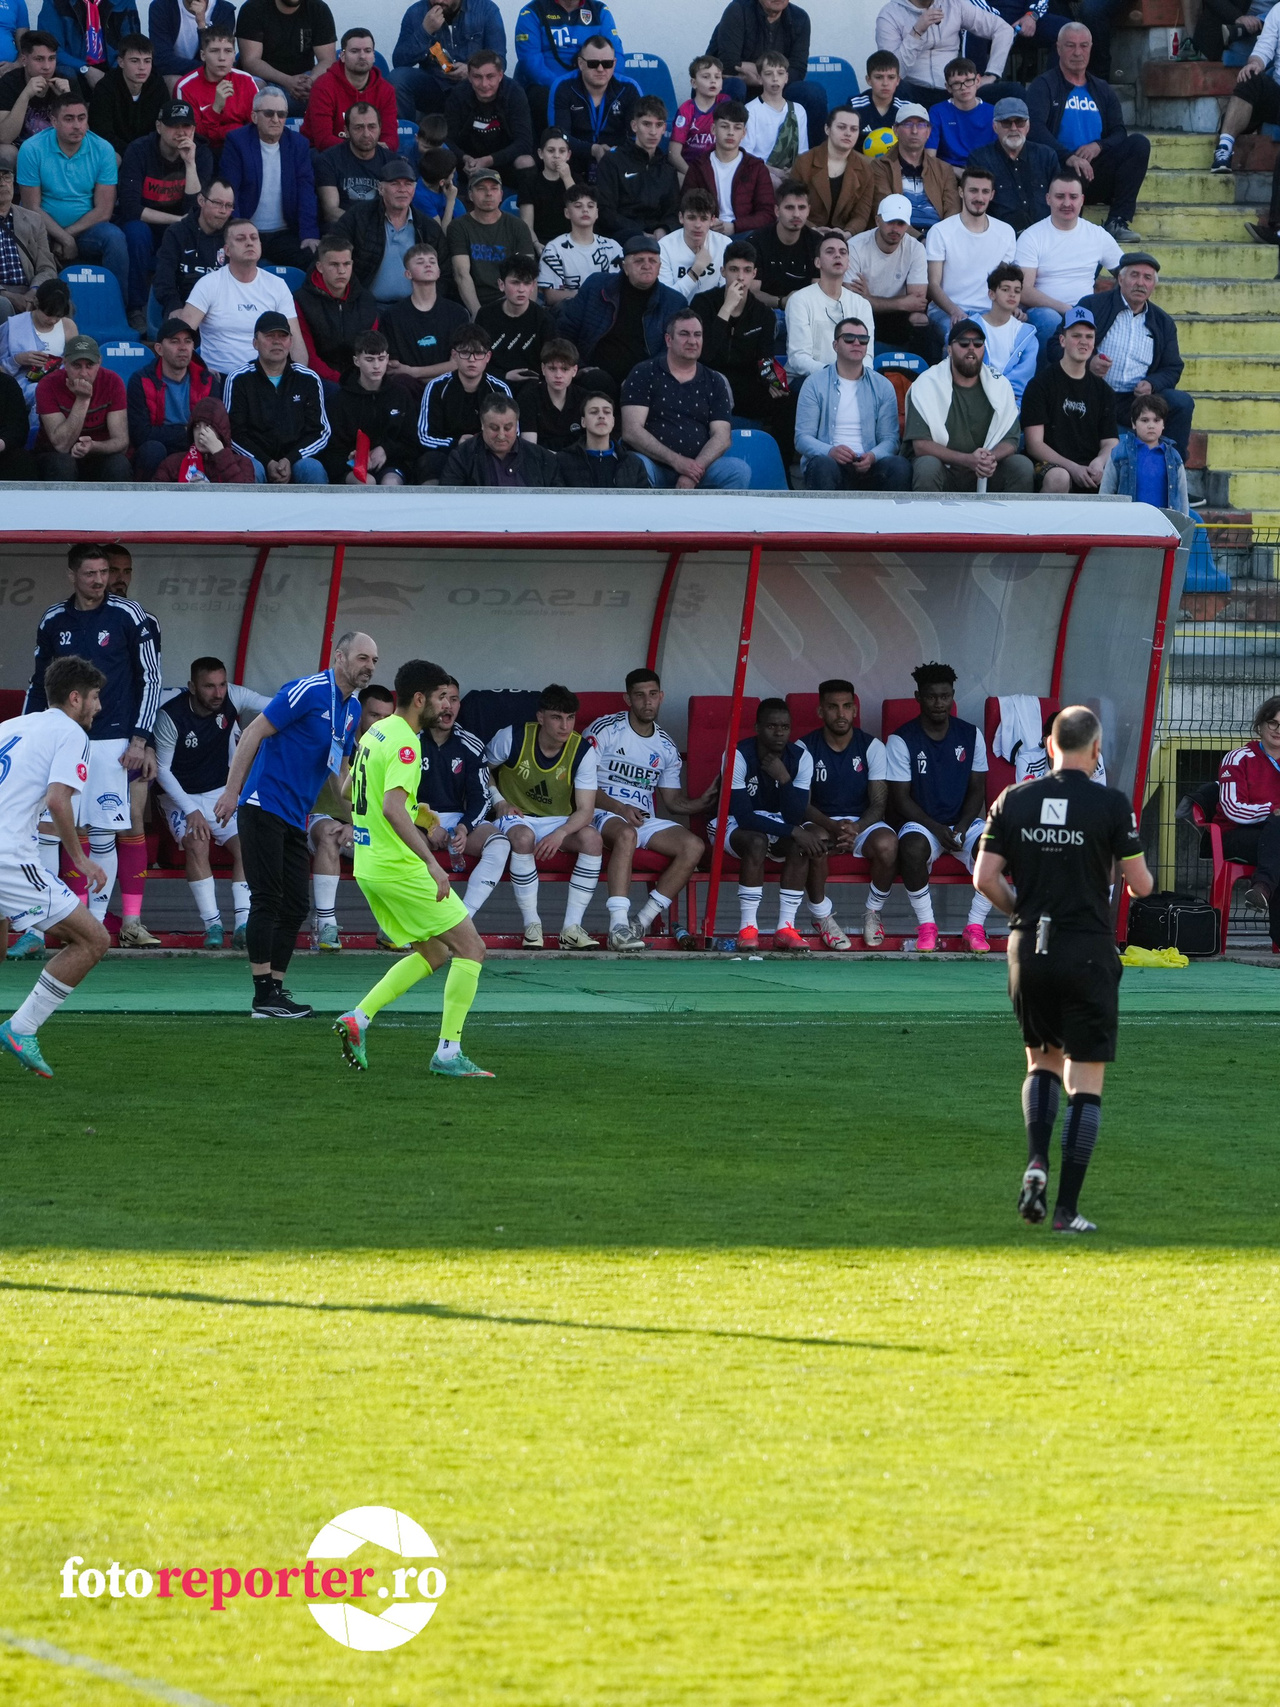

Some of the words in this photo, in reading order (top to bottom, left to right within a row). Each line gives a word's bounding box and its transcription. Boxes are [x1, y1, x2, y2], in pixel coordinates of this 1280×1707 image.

[343, 177, 355, 191] LOS
[677, 263, 715, 279] BS
[59, 631, 72, 646] 32
[184, 737, 199, 748] 98
[517, 765, 531, 780] 70
[608, 760, 661, 782] UNIBET
[917, 759, 928, 774] 12
[815, 768, 828, 782] 10
[1020, 827, 1085, 846] NORDIS
